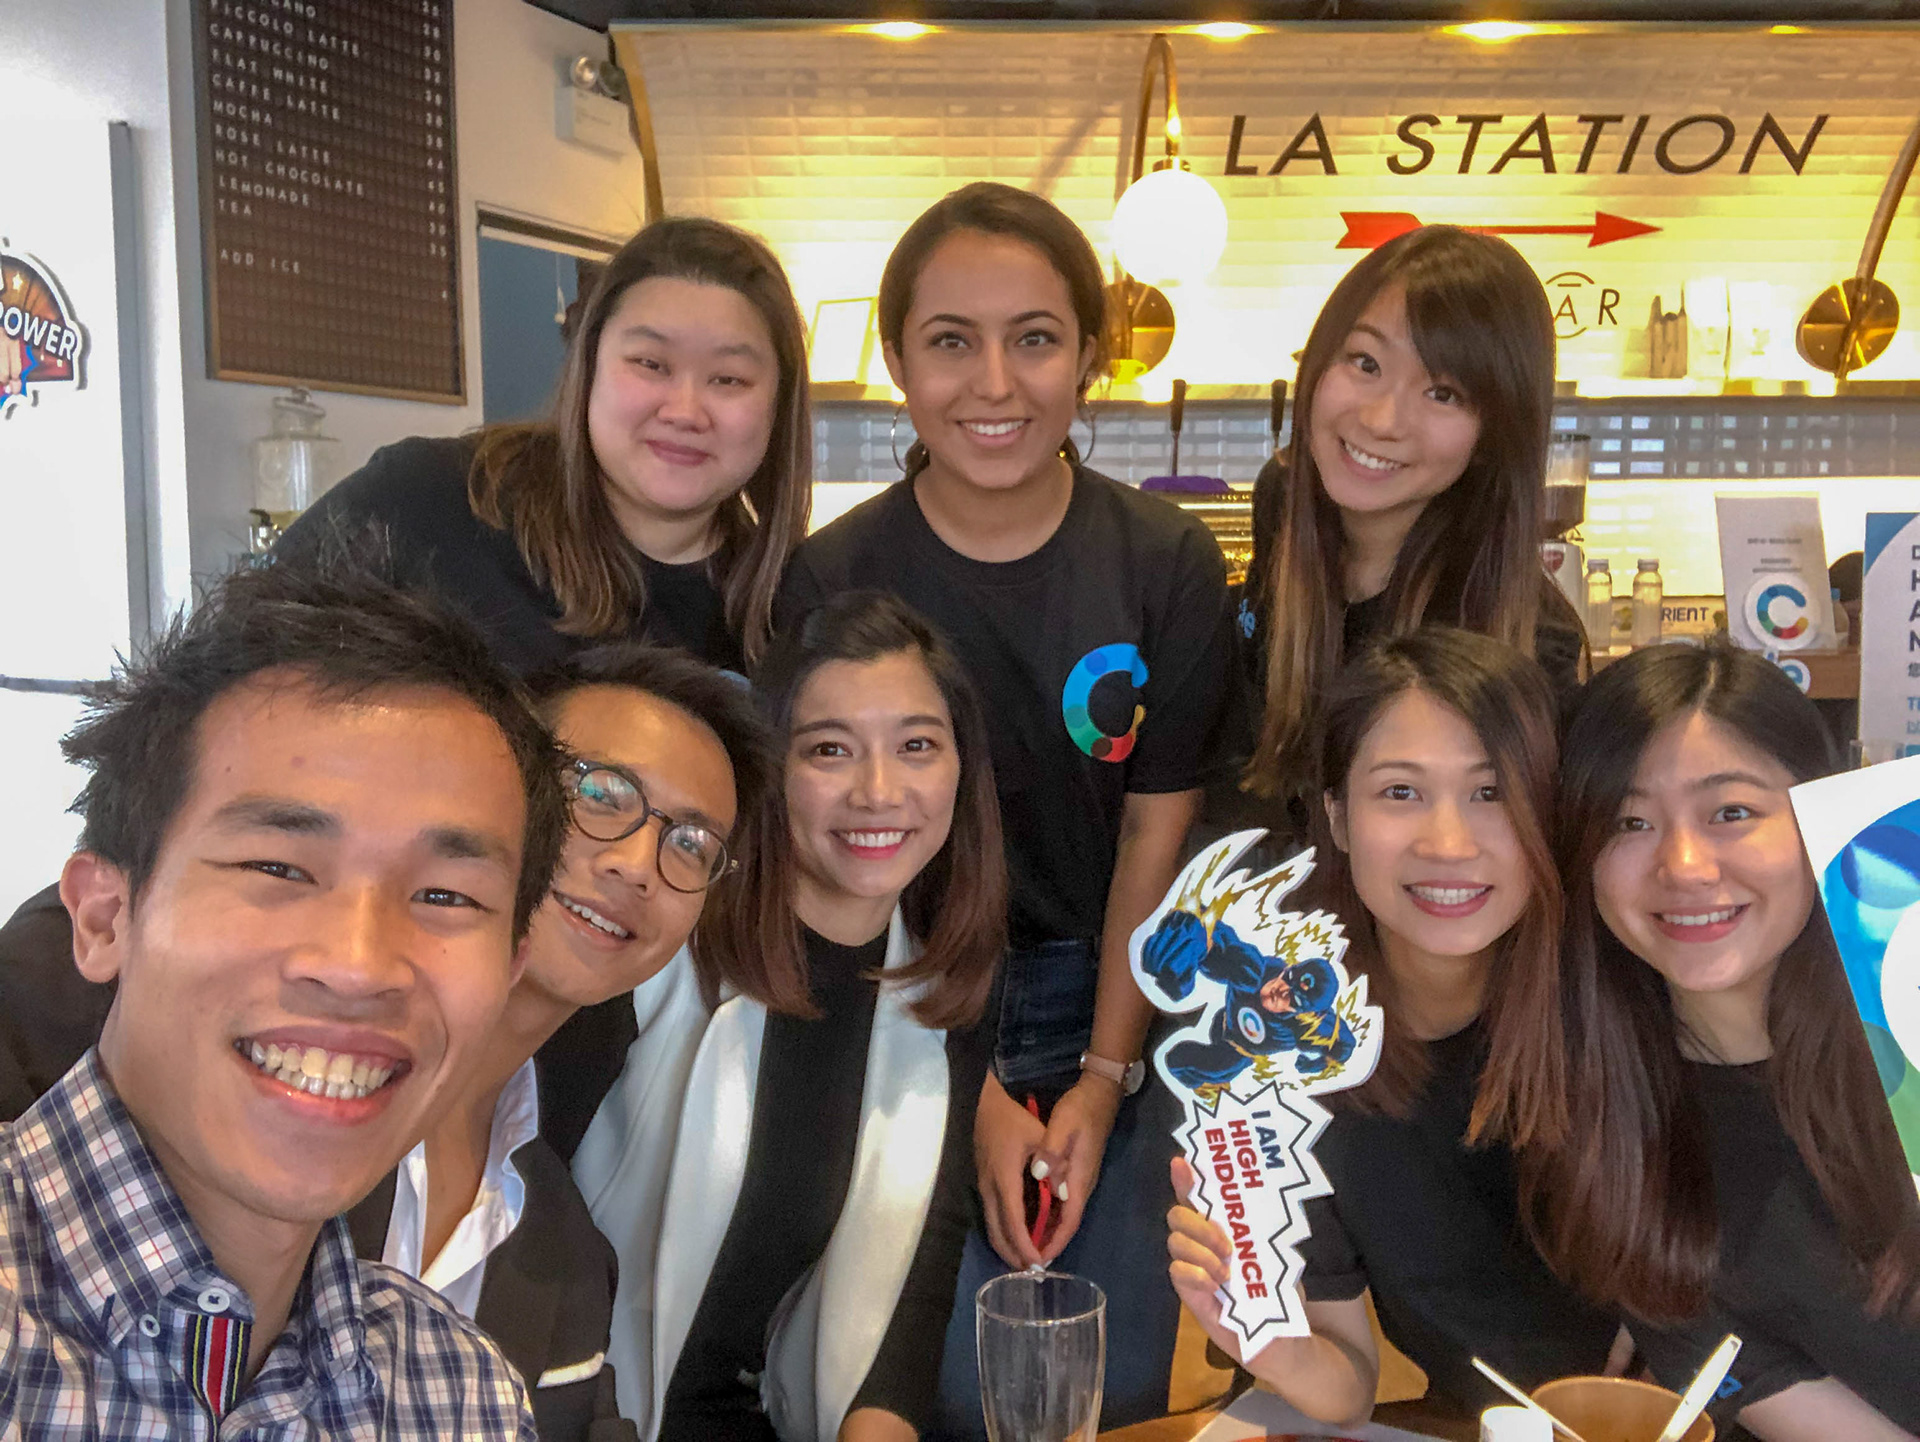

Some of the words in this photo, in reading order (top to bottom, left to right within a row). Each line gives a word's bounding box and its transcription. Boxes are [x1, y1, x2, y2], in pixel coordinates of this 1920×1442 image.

[209, 0, 294, 34] PICCOLO
[308, 29, 360, 57] LATTE
[209, 23, 328, 70] CAPPUCCINO
[212, 48, 258, 74] FLAT
[272, 67, 328, 95] WHITE
[212, 73, 271, 101] CAFFE
[286, 94, 340, 120] LATTE
[213, 100, 273, 125] MOCHA
[215, 124, 261, 146] ROSE
[277, 140, 330, 165] LATTE
[1224, 112, 1338, 176] LA
[1386, 112, 1830, 176] STATION
[215, 150, 249, 168] HOT
[264, 161, 364, 196] CHOCOLATE
[219, 175, 311, 206] LEMONADE
[218, 198, 251, 216] TEA
[220, 249, 254, 266] ADD
[270, 258, 300, 274] ICE
[1553, 287, 1620, 326] AR
[0, 305, 76, 360] OWER
[1661, 605, 1709, 622] RIENT
[1251, 1110, 1271, 1120] I
[1228, 1119, 1264, 1189] HIGH
[1255, 1126, 1286, 1170] AM
[1205, 1128, 1268, 1299] ENDURANCE
